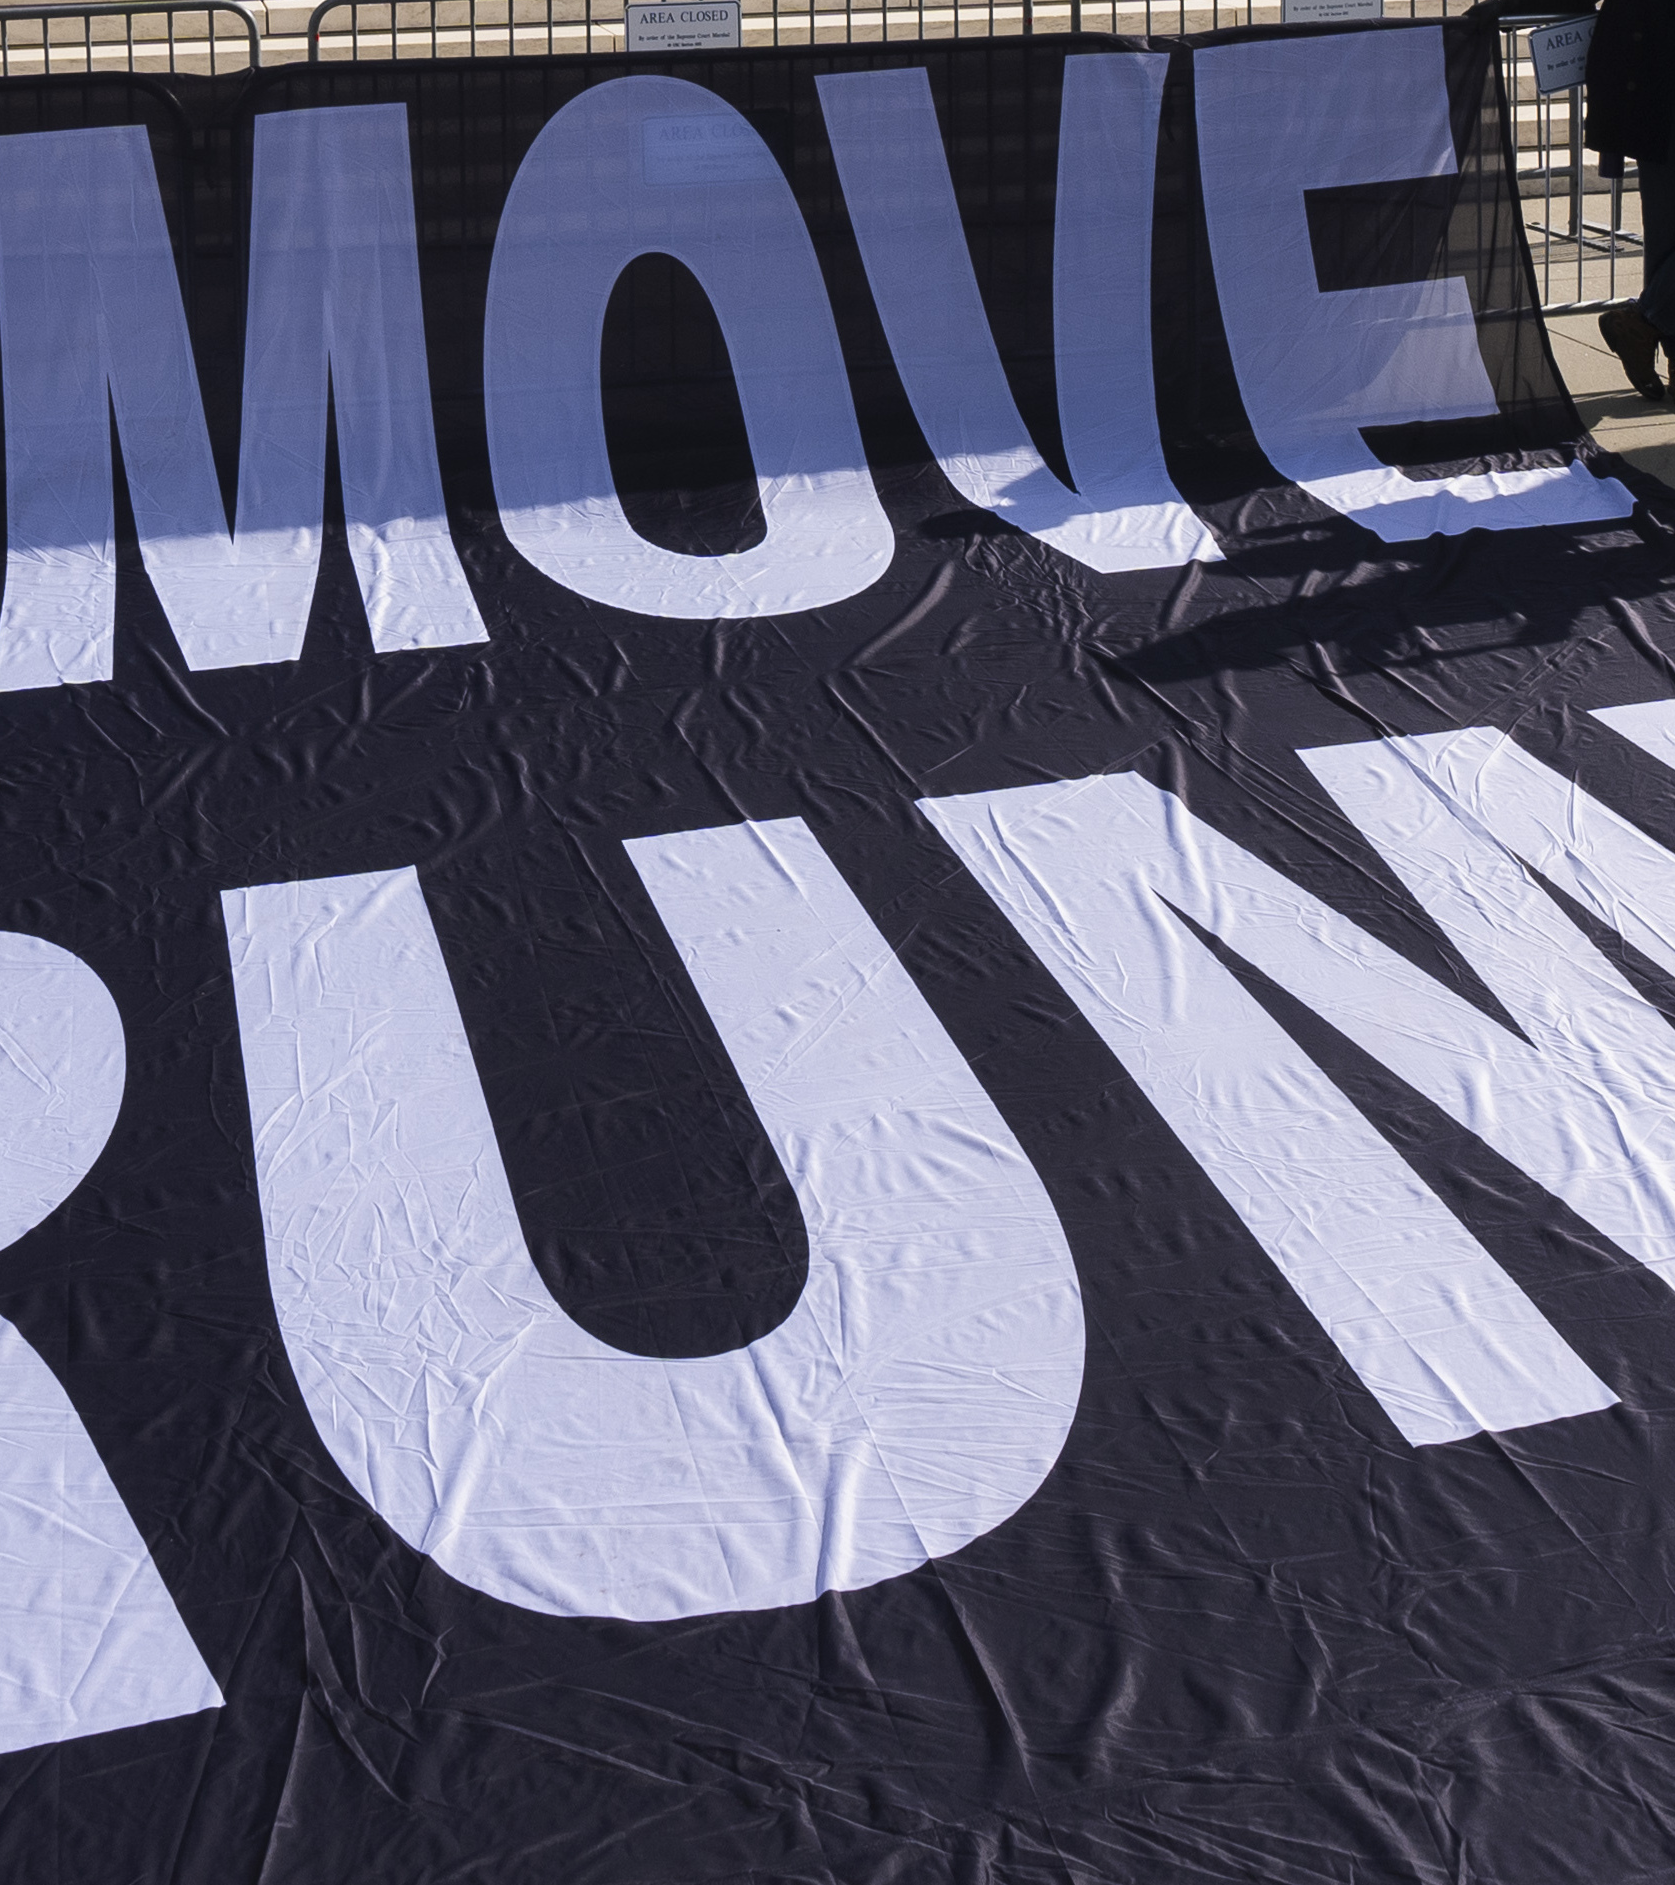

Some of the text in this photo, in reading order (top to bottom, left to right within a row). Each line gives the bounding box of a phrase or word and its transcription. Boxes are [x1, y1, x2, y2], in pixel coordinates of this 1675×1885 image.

[640, 10, 729, 24] AREA CLOSED
[1546, 31, 1583, 51] AREA
